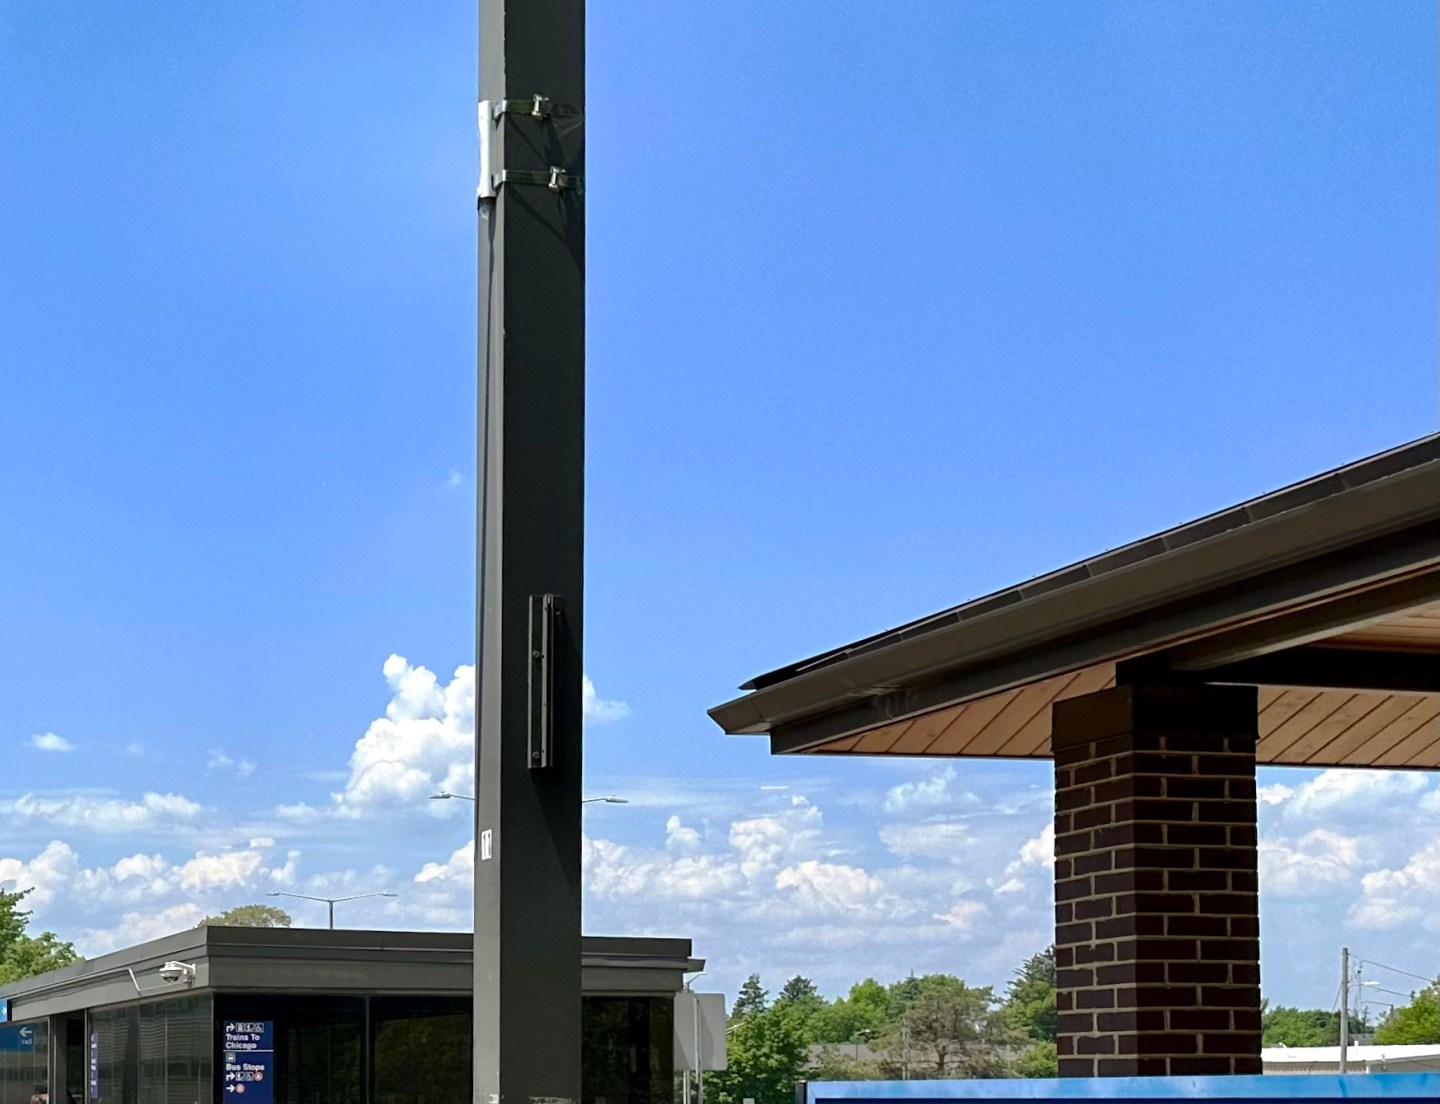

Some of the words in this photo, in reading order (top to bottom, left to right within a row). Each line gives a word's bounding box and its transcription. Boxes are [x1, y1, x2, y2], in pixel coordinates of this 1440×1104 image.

[226, 1033, 249, 1041] Trains
[251, 1033, 260, 1041] To
[226, 1042, 257, 1050] Chicago
[226, 1063, 241, 1071] Bus
[243, 1063, 265, 1072] Stops
